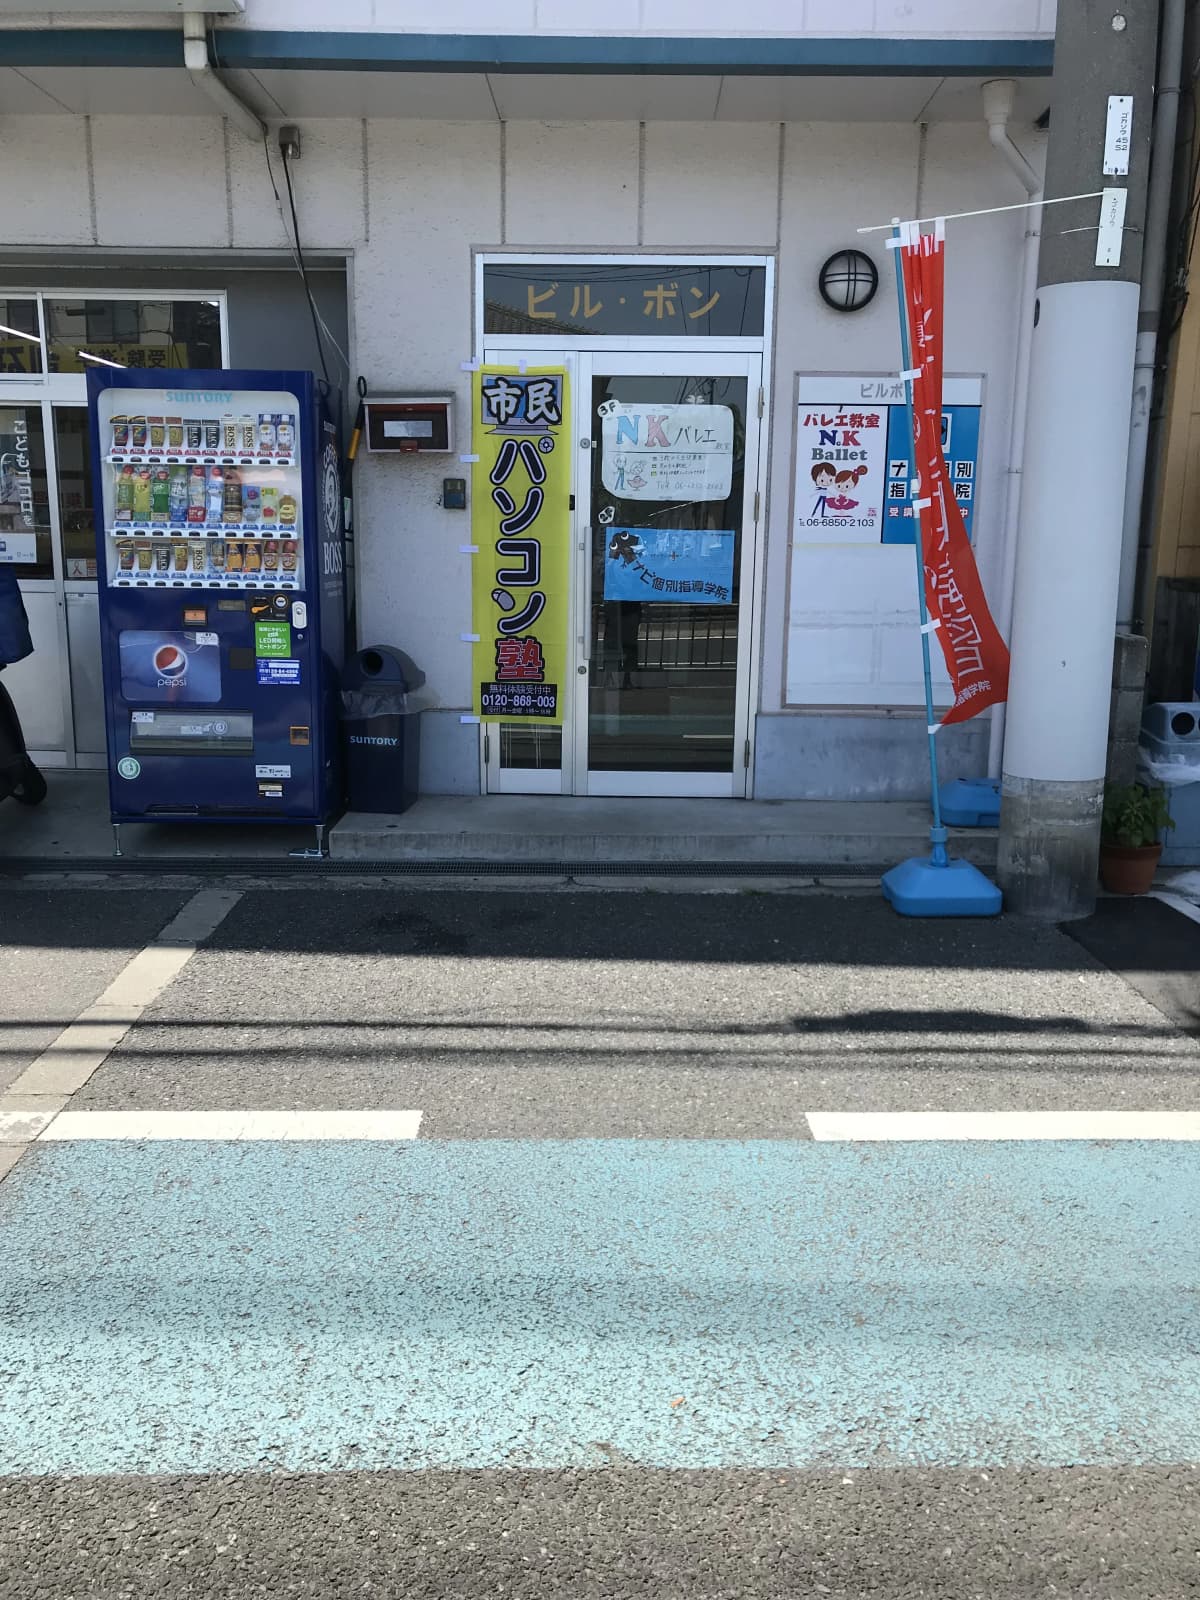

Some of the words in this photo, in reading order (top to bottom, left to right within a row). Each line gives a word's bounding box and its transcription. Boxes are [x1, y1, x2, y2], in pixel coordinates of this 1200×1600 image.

[527, 282, 721, 319] ビル・ボン
[860, 384, 914, 398] ビルボ
[483, 378, 561, 424] 市民
[803, 413, 880, 428] バレエ教室
[227, 426, 235, 447] BOSS
[811, 448, 868, 461] Ballet
[806, 518, 874, 527] 06-6850-2103
[323, 542, 342, 575] BOSS
[632, 560, 729, 600] ナビ個別指導学院
[157, 678, 187, 688] pepsi
[482, 694, 555, 708] 0120-868-003
[350, 735, 398, 746] SUNTORY
